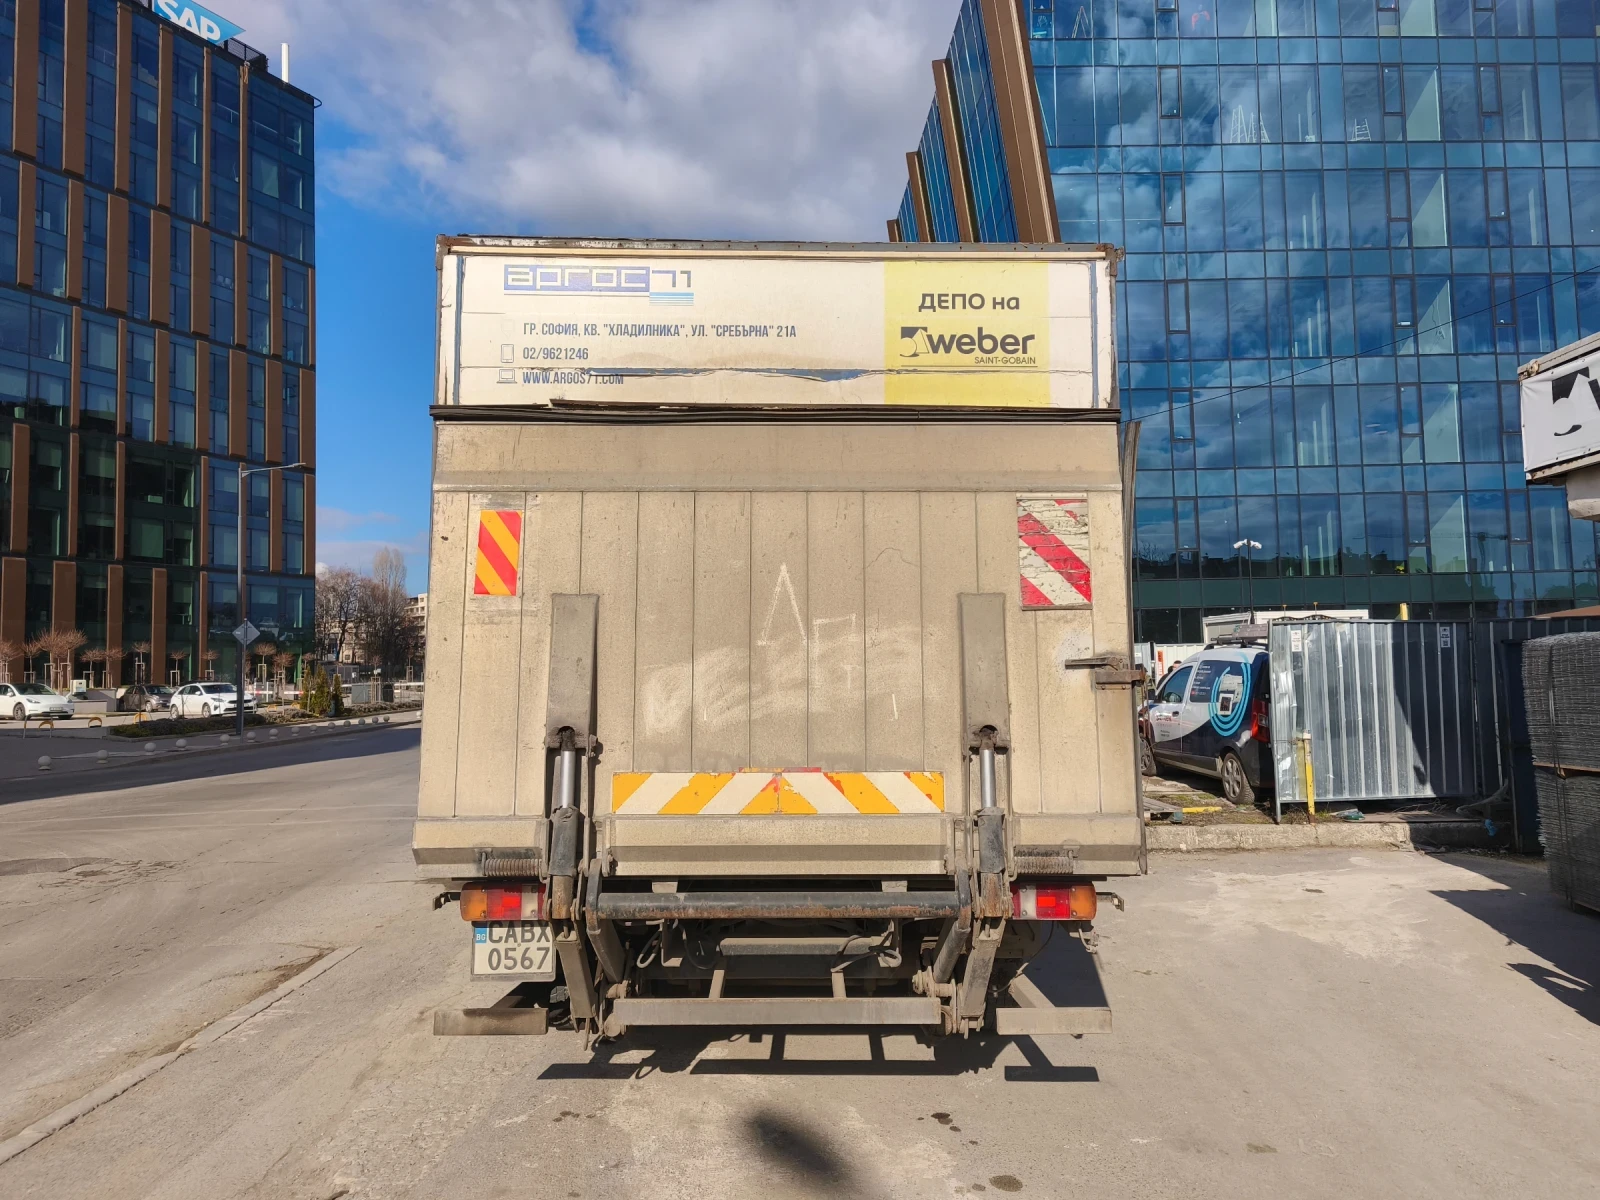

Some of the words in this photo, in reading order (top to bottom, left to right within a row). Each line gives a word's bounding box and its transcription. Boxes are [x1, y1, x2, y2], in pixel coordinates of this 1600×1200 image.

[158, 0, 221, 41] SAP
[918, 293, 986, 313] ДЕПО
[992, 297, 1020, 310] на
[523, 322, 539, 336] ГР.
[541, 322, 581, 337] СОФИЯ,
[583, 323, 601, 336] КВ.
[603, 323, 688, 338] "ХЛАДИЛНИКА",
[691, 324, 708, 337] УЛ.
[711, 324, 774, 338] "СРЕБЪРНА"
[776, 325, 797, 338] 21А
[926, 326, 1036, 355] weber
[522, 347, 589, 360] 02/9621246
[974, 356, 1037, 365] SAINT-GOBAIN
[476, 933, 486, 941] BG
[488, 920, 551, 944] CABX
[487, 946, 551, 971] 0567
